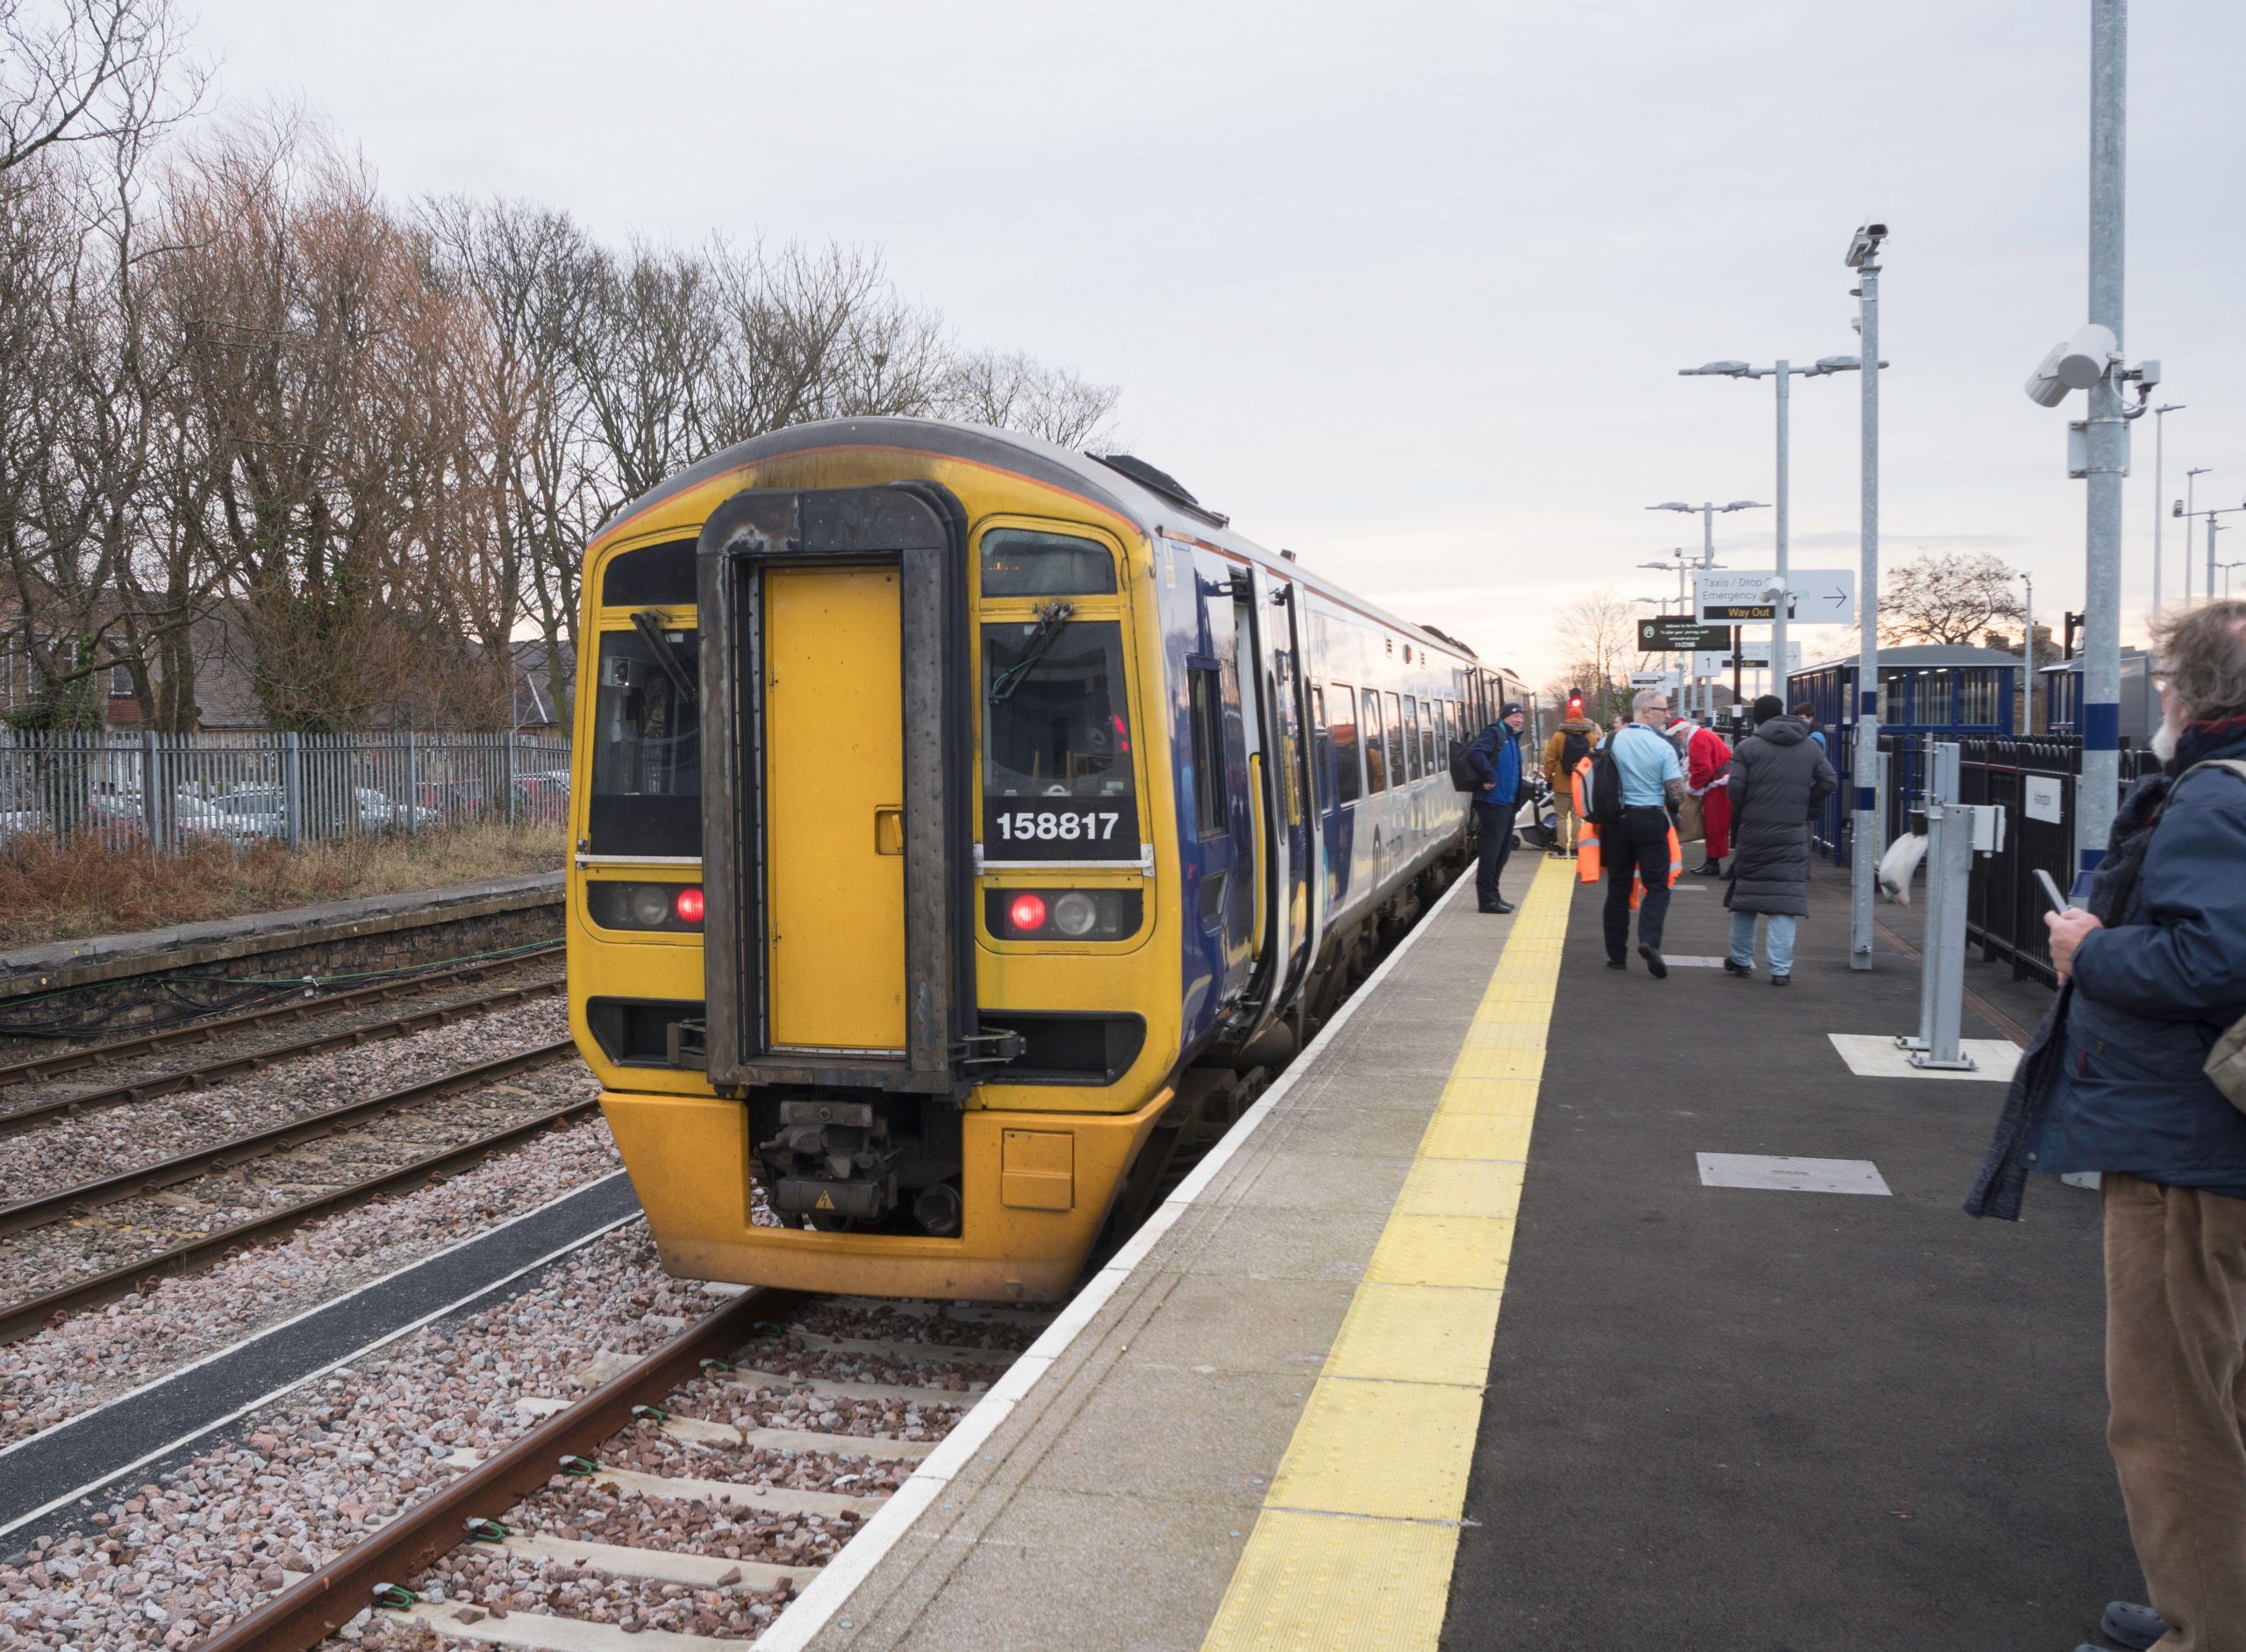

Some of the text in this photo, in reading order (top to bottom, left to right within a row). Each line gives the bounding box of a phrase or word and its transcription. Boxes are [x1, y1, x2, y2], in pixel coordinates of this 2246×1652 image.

[1703, 577, 1728, 588] Taxis
[1731, 577, 1736, 587] /
[1739, 577, 1763, 589] Drop
[1702, 590, 1756, 602] Emergency
[1727, 607, 1770, 619] Way Out
[1705, 656, 1711, 669] 1
[997, 812, 1119, 840] 158817
